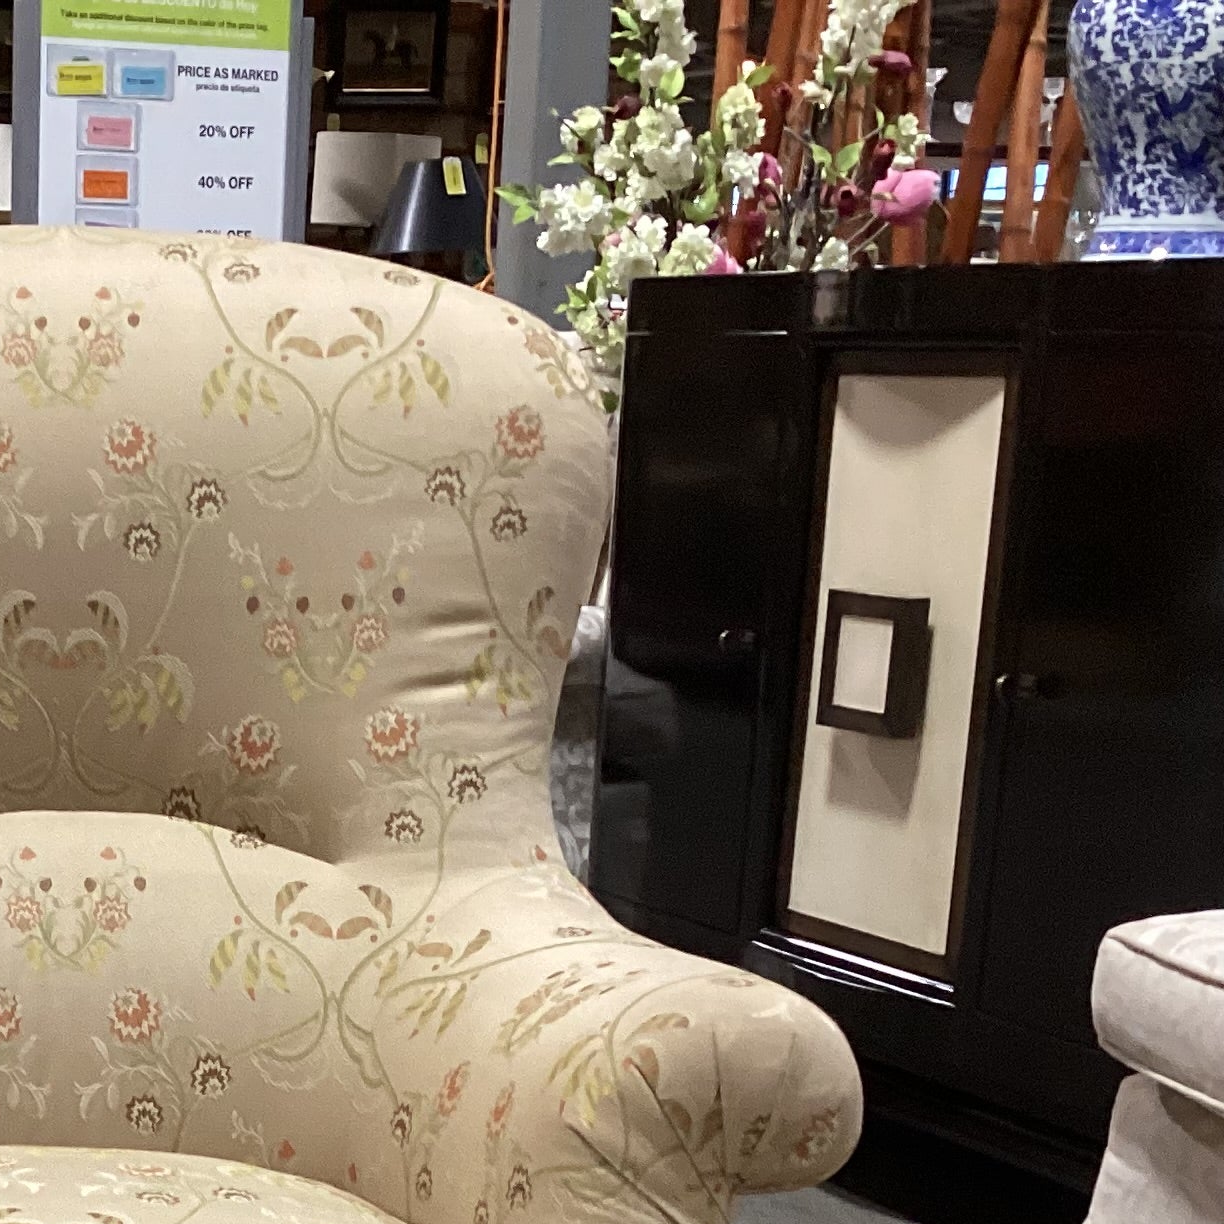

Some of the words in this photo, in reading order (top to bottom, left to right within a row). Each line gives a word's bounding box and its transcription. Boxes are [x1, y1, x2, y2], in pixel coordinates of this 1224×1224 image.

[177, 65, 211, 78] PRICE
[214, 67, 229, 79] AS
[231, 68, 279, 81] MARKED
[196, 83, 218, 91] precio
[230, 84, 260, 93] etiqueta
[199, 124, 226, 138] 20%
[229, 125, 255, 139] OFF
[198, 176, 225, 189] 40%
[228, 176, 254, 189] OFF
